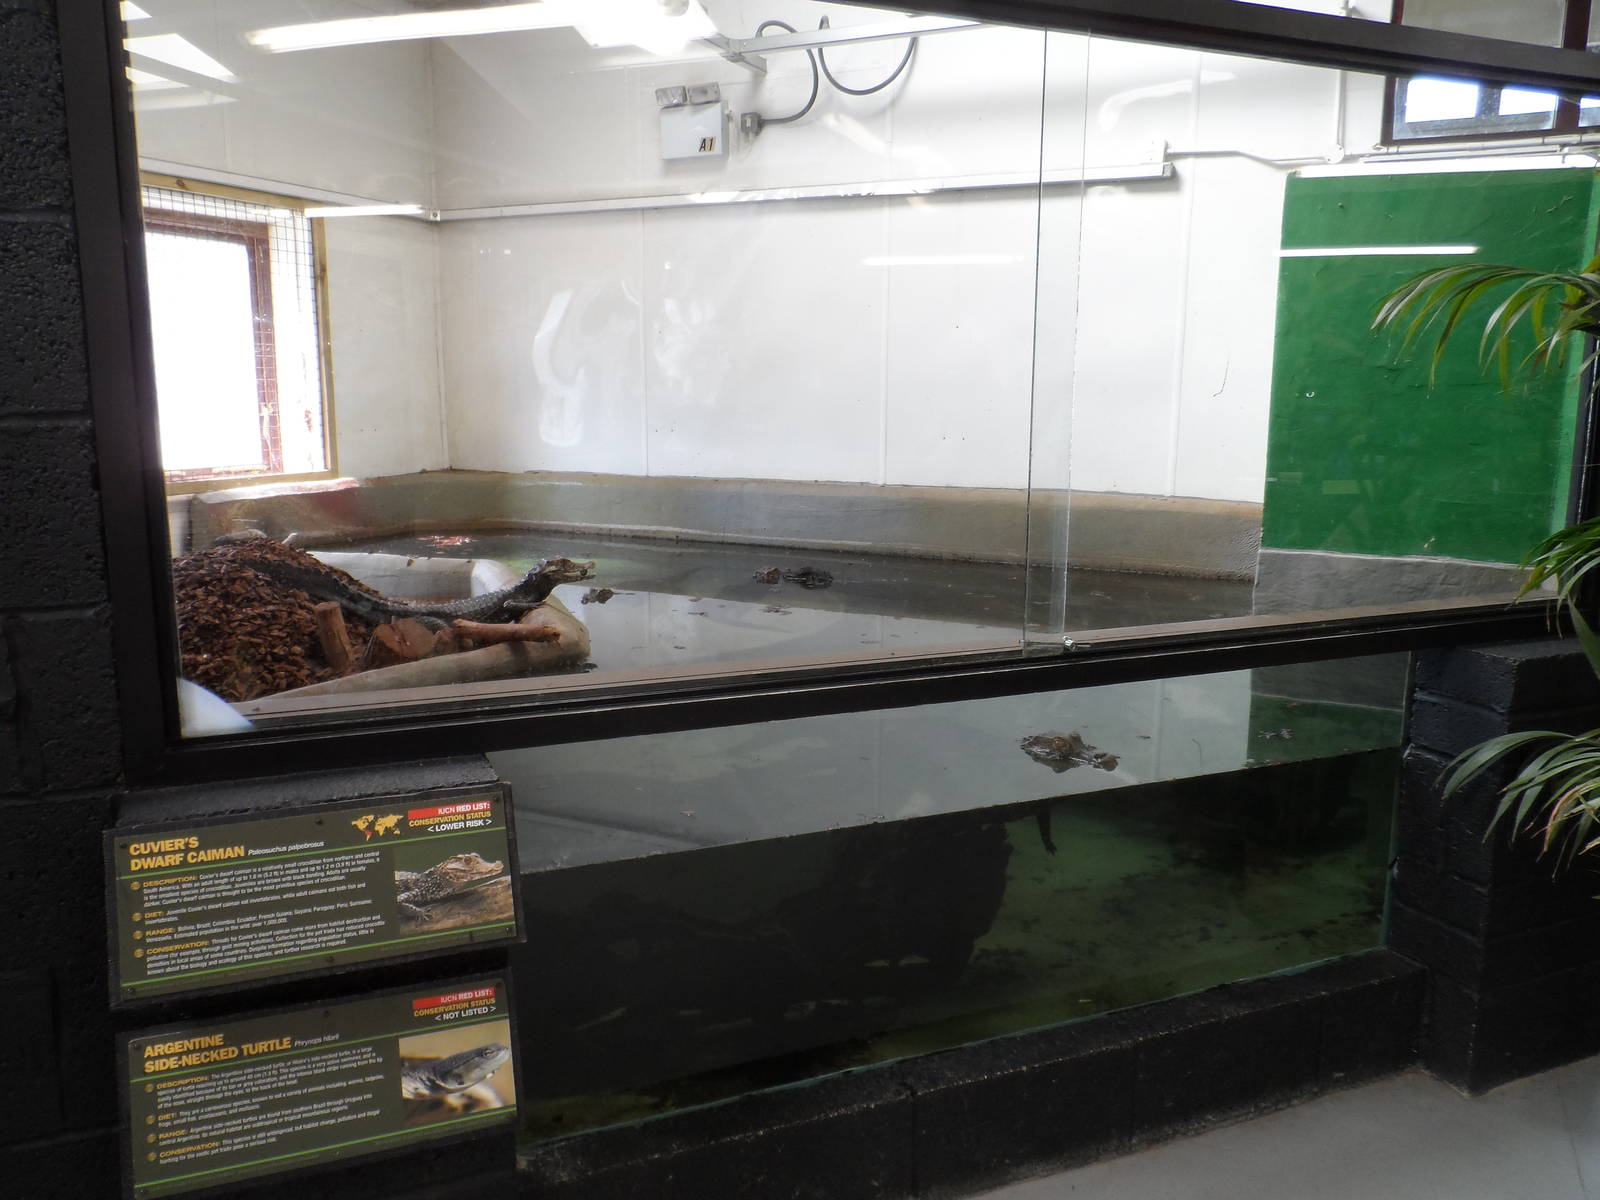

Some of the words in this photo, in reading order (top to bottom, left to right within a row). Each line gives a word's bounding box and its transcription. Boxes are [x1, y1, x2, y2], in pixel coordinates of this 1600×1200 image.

[438, 805, 455, 816] IUCN
[456, 803, 472, 813] RED
[473, 802, 491, 811] LIST:
[409, 814, 465, 828] CONSERVATION
[465, 810, 492, 820] STATUS
[435, 821, 465, 832] LOWER
[466, 819, 484, 828] RISK
[129, 836, 199, 856] CUVIER'S
[130, 853, 184, 871] DWARF
[187, 845, 245, 864] CAIMAN
[440, 995, 457, 1003] IUCN
[458, 991, 474, 1000] RED
[474, 988, 493, 997] LIST:
[413, 1002, 469, 1017] CONSERVATION
[470, 998, 496, 1008] STATUS
[443, 1011, 460, 1020] NOT
[461, 1006, 489, 1017] LISTED
[144, 1034, 224, 1058] ARGENTINE
[144, 1047, 239, 1074] SIDE-NECKED
[241, 1036, 292, 1058] TURTLE
